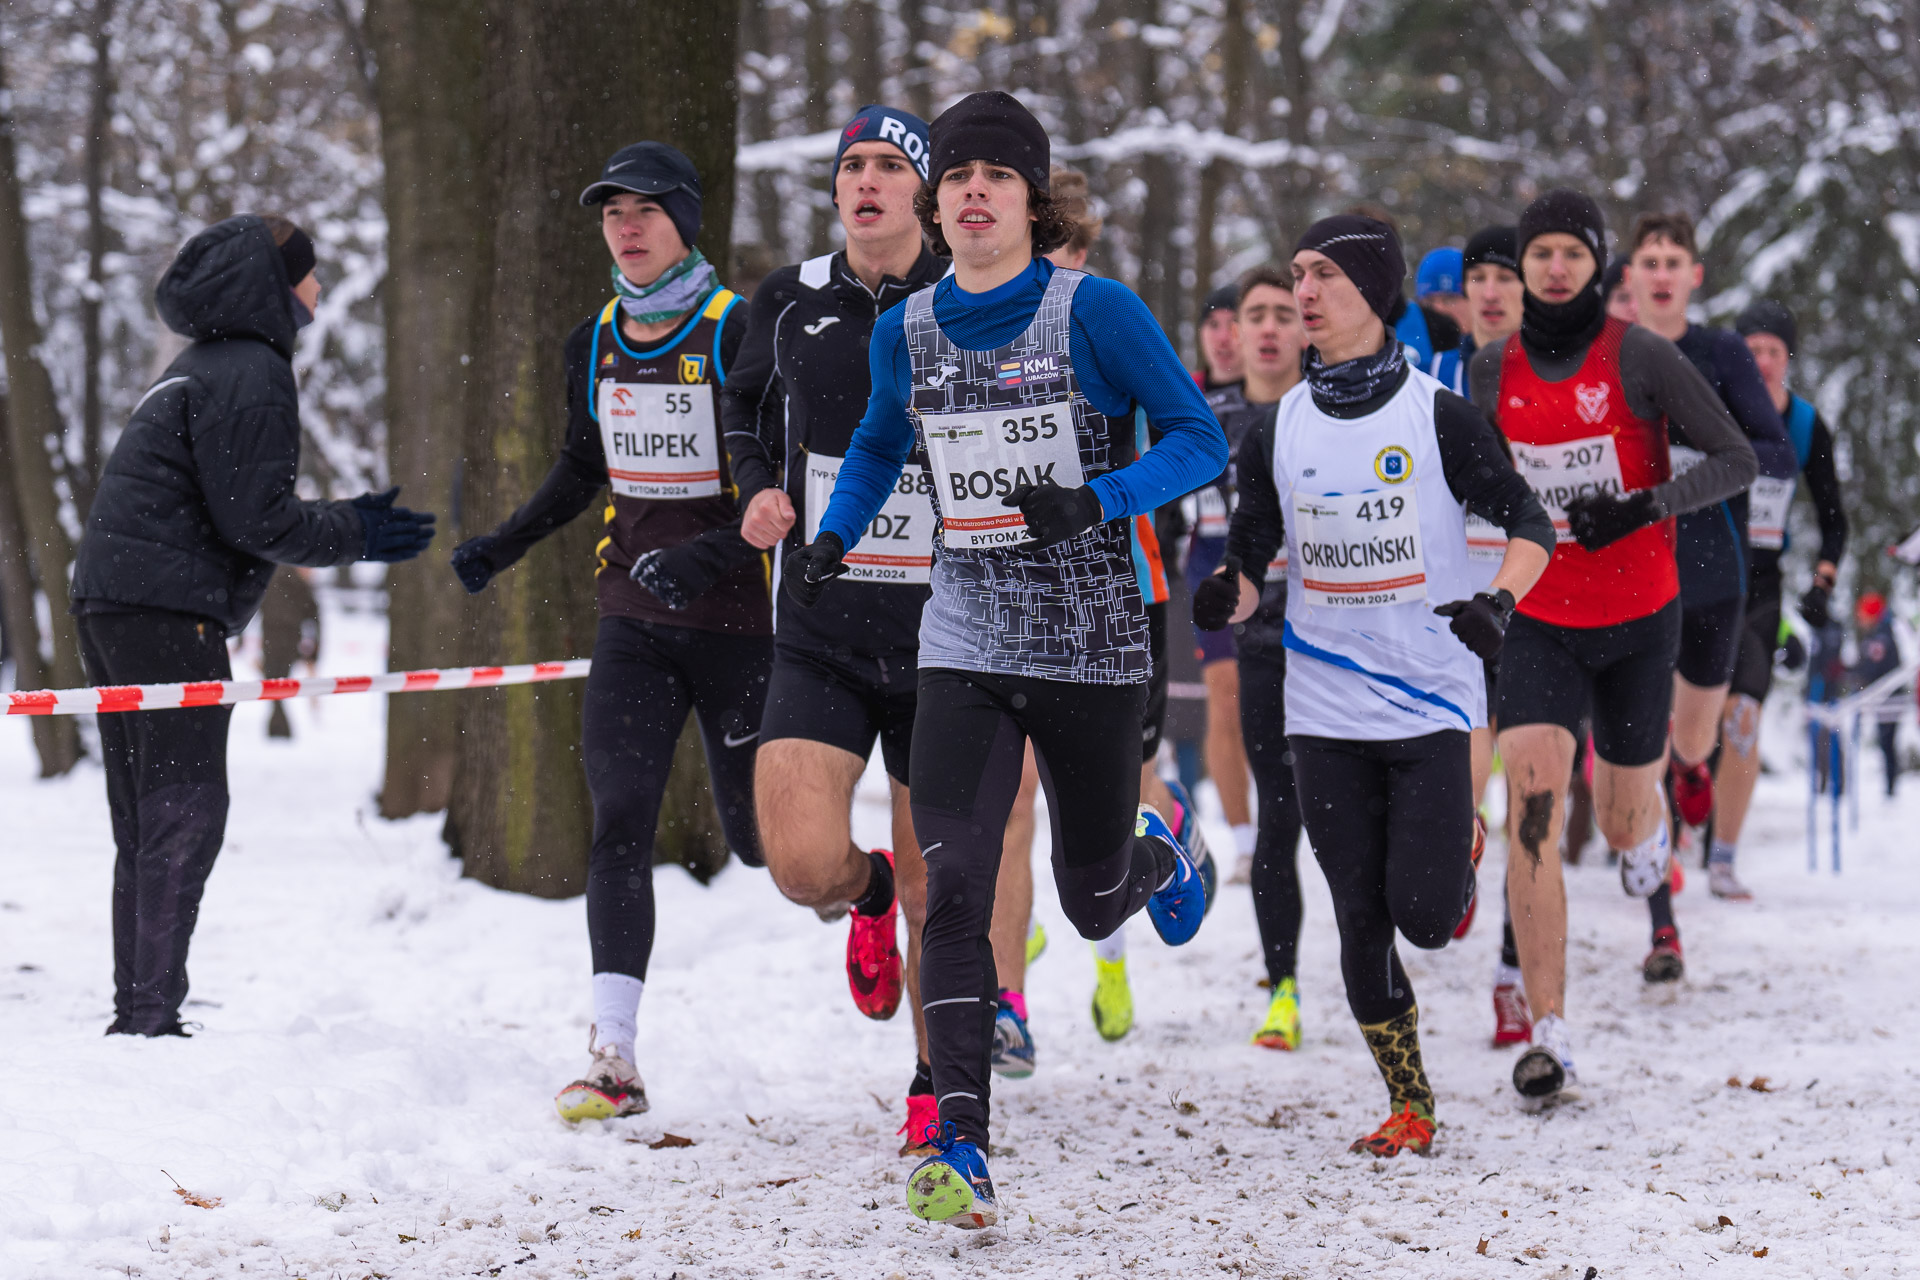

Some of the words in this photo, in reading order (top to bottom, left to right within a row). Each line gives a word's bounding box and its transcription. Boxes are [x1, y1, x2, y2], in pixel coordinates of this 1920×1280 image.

[1023, 356, 1058, 374] KML
[1025, 371, 1059, 382] LUBACZÓW
[610, 409, 636, 417] ORLEN
[665, 393, 692, 414] 55
[1002, 413, 1058, 444] 355
[613, 432, 700, 458] FILIPEK
[1563, 444, 1604, 470] 207
[811, 468, 829, 479] TVP
[949, 461, 1058, 501] BOSAK
[629, 484, 659, 494] BYTOM
[662, 486, 689, 495] 2024
[892, 472, 930, 495] 88
[1356, 496, 1405, 523] 419
[861, 513, 911, 540] DZ
[995, 516, 1014, 525] Polski
[970, 531, 1018, 545] BYTOM
[1302, 534, 1416, 569] OKRUCIŃSKI
[876, 569, 906, 579] 2024
[1327, 594, 1365, 605] BYTOM
[1368, 592, 1397, 604] 2024
